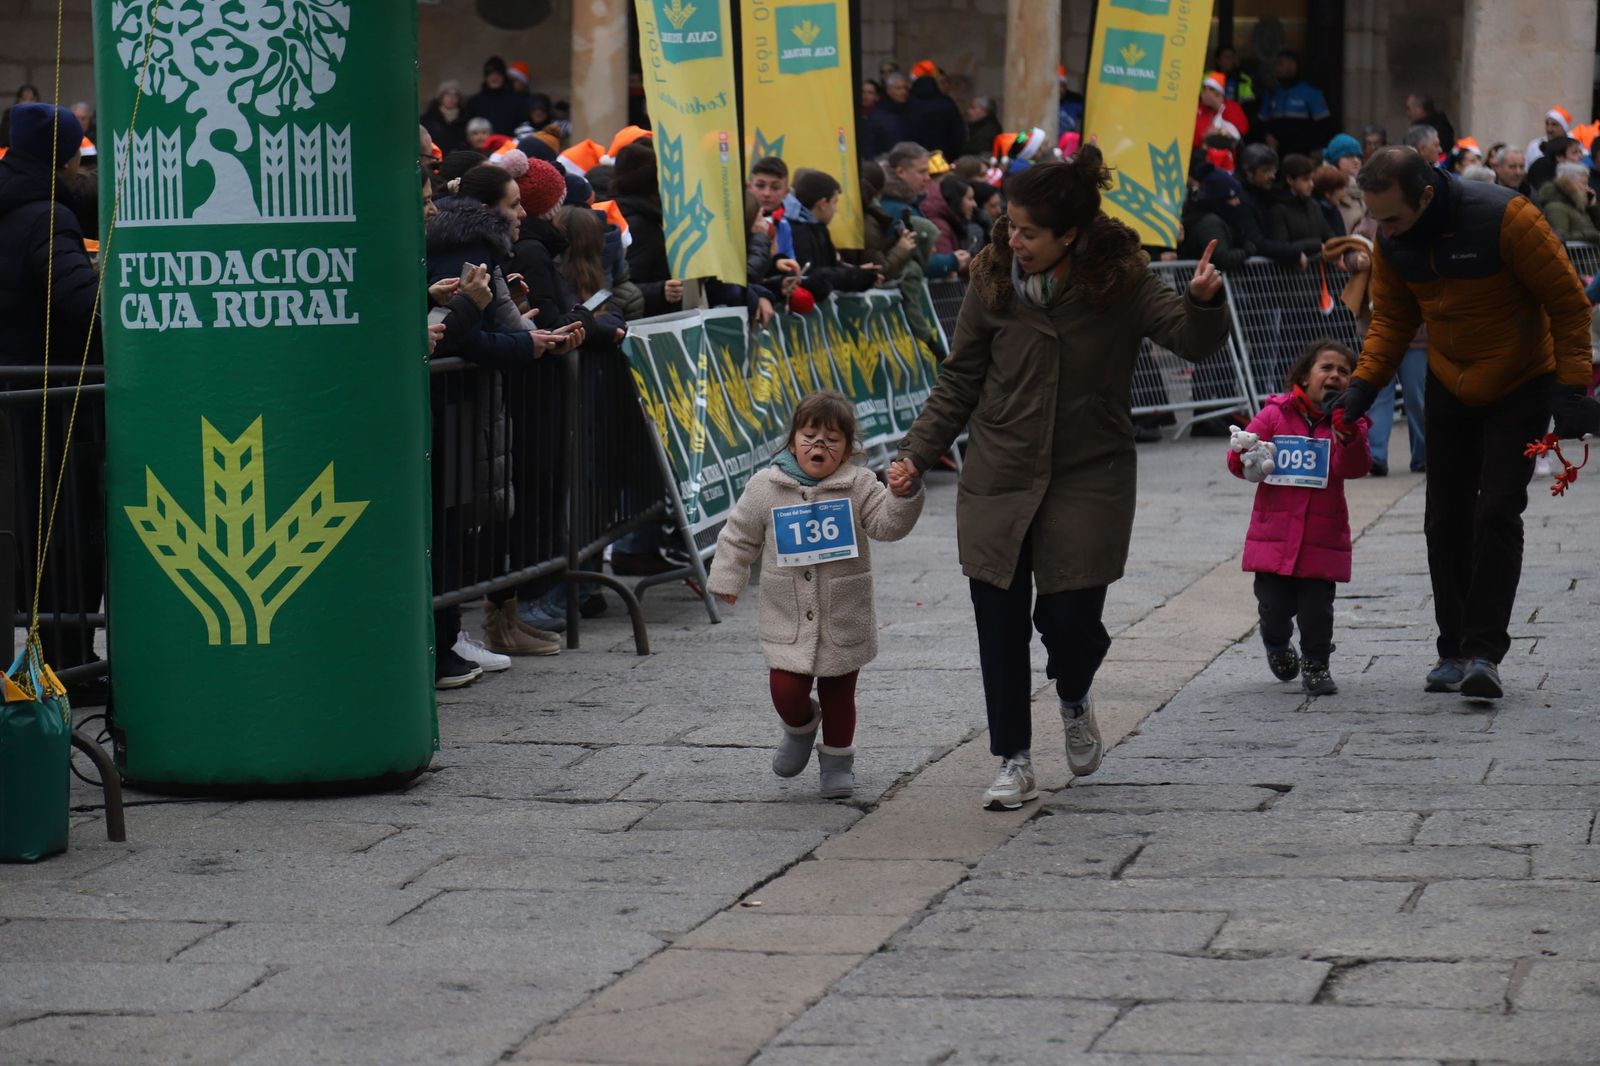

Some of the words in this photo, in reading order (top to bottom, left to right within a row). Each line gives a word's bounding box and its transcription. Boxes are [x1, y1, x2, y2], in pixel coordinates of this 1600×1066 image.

[1162, 59, 1181, 102] León
[118, 247, 357, 287] FUNDACION
[120, 292, 203, 333] CAJA
[212, 288, 360, 328] RURAL
[1277, 449, 1317, 470] 093
[788, 516, 840, 546] 136
